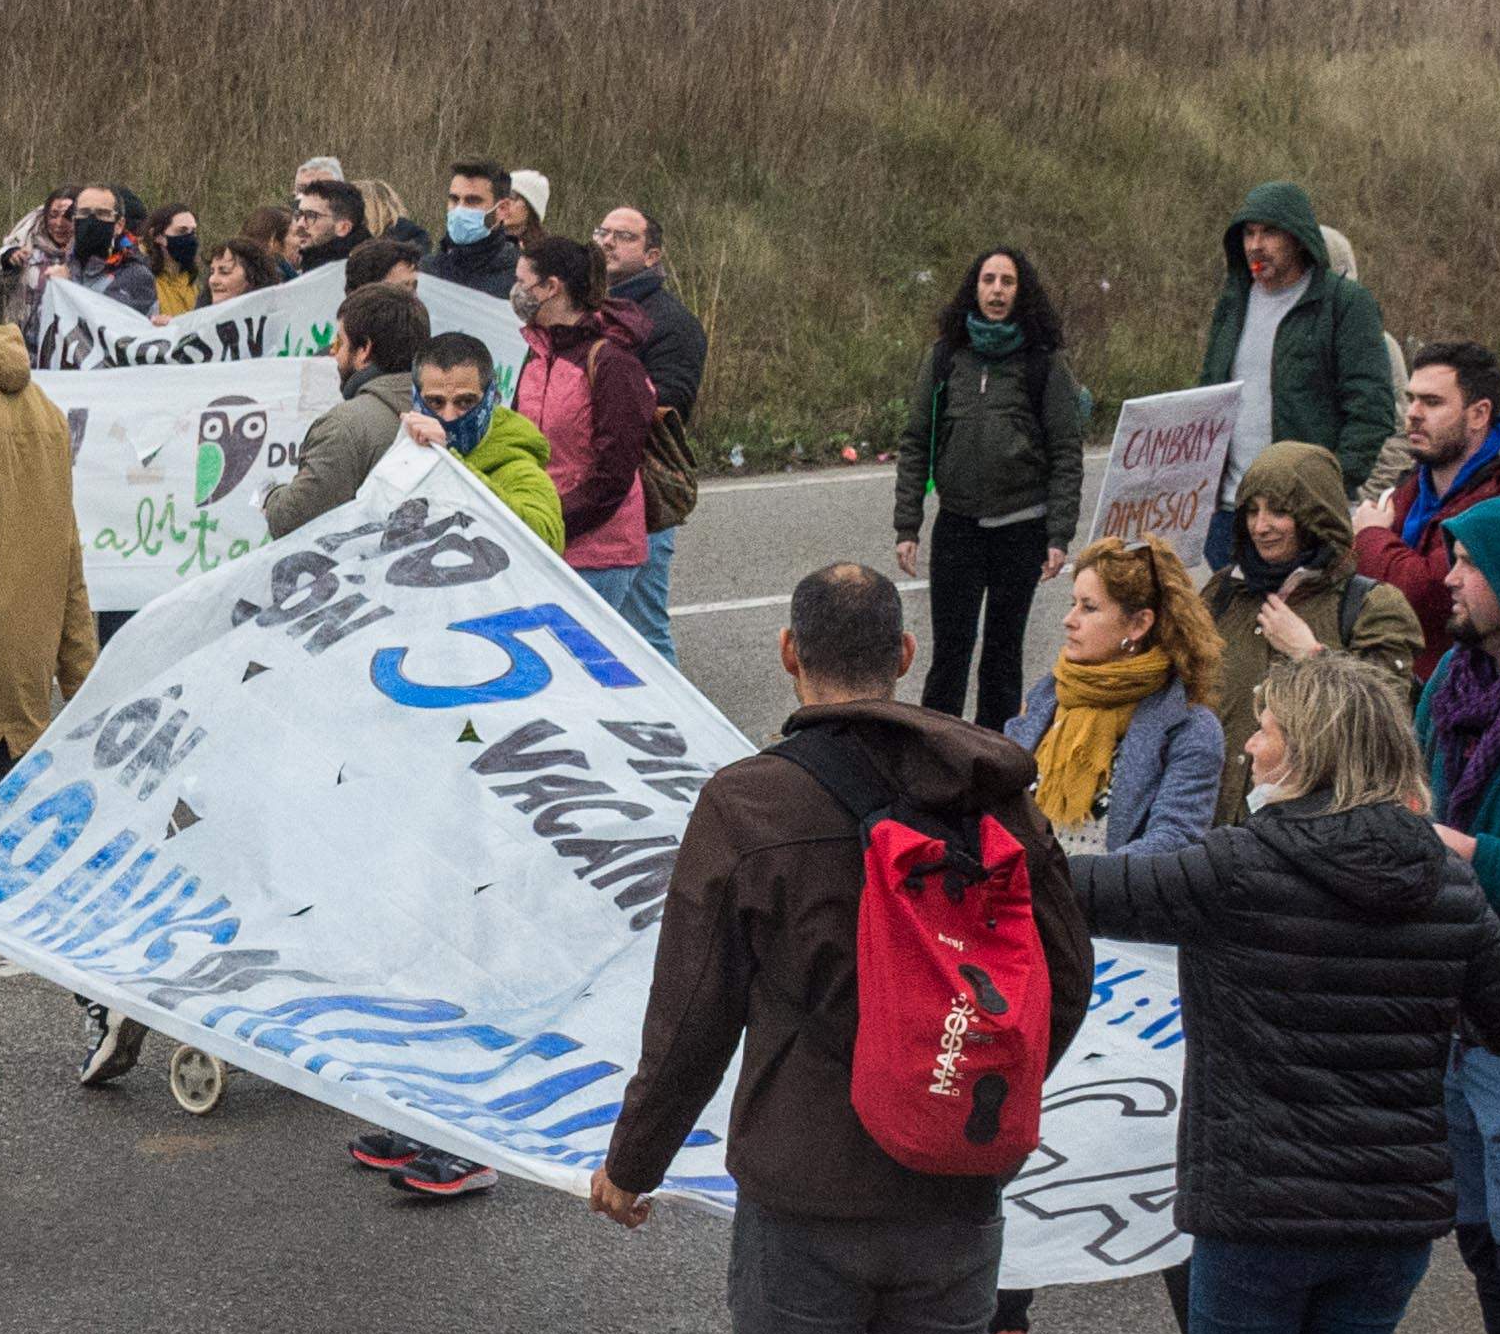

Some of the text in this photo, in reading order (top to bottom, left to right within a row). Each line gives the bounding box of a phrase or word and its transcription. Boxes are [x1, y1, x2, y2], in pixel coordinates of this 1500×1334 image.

[1123, 416, 1227, 470] CAMBRAY
[1104, 478, 1208, 538] DIMISSIÓ
[370, 603, 646, 708] 5
